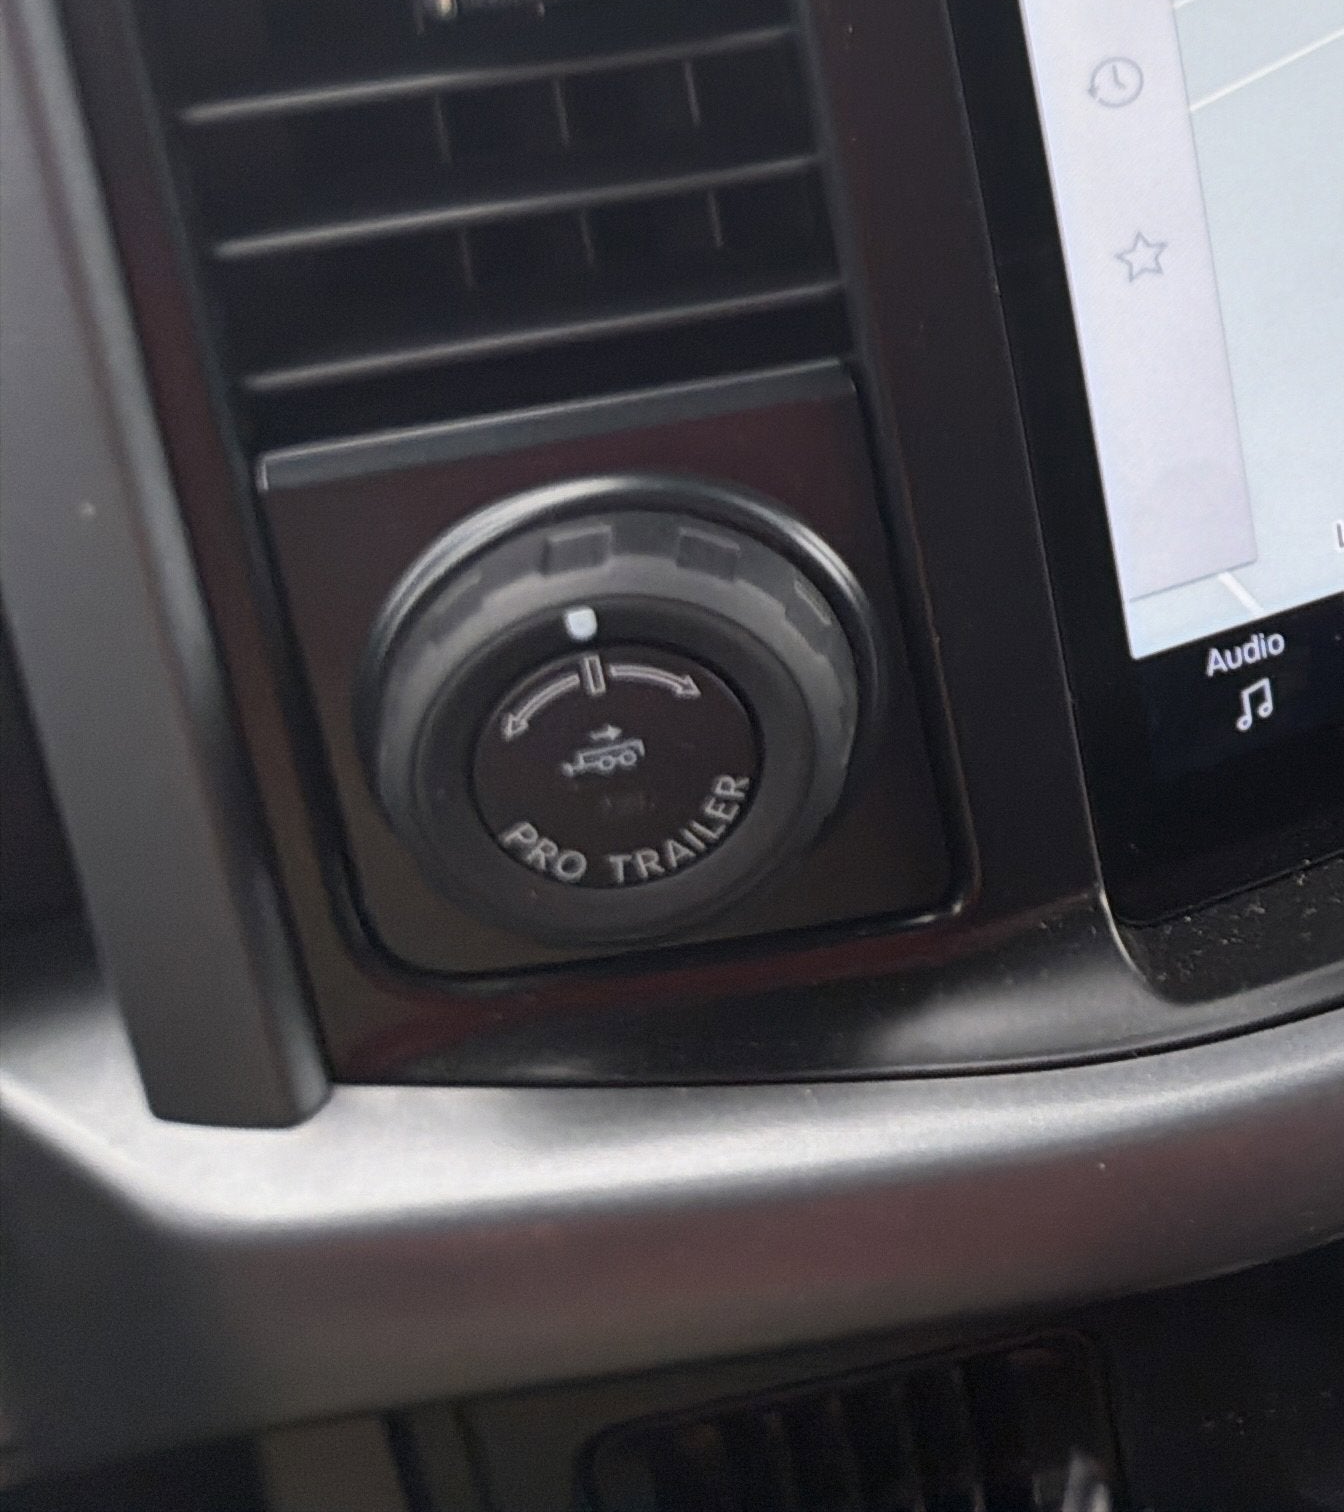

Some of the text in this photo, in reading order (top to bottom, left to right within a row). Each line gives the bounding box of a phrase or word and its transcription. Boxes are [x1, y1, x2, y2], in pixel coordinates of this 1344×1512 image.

[1205, 634, 1286, 677] Audio
[503, 773, 751, 884] PRO TRAILER
